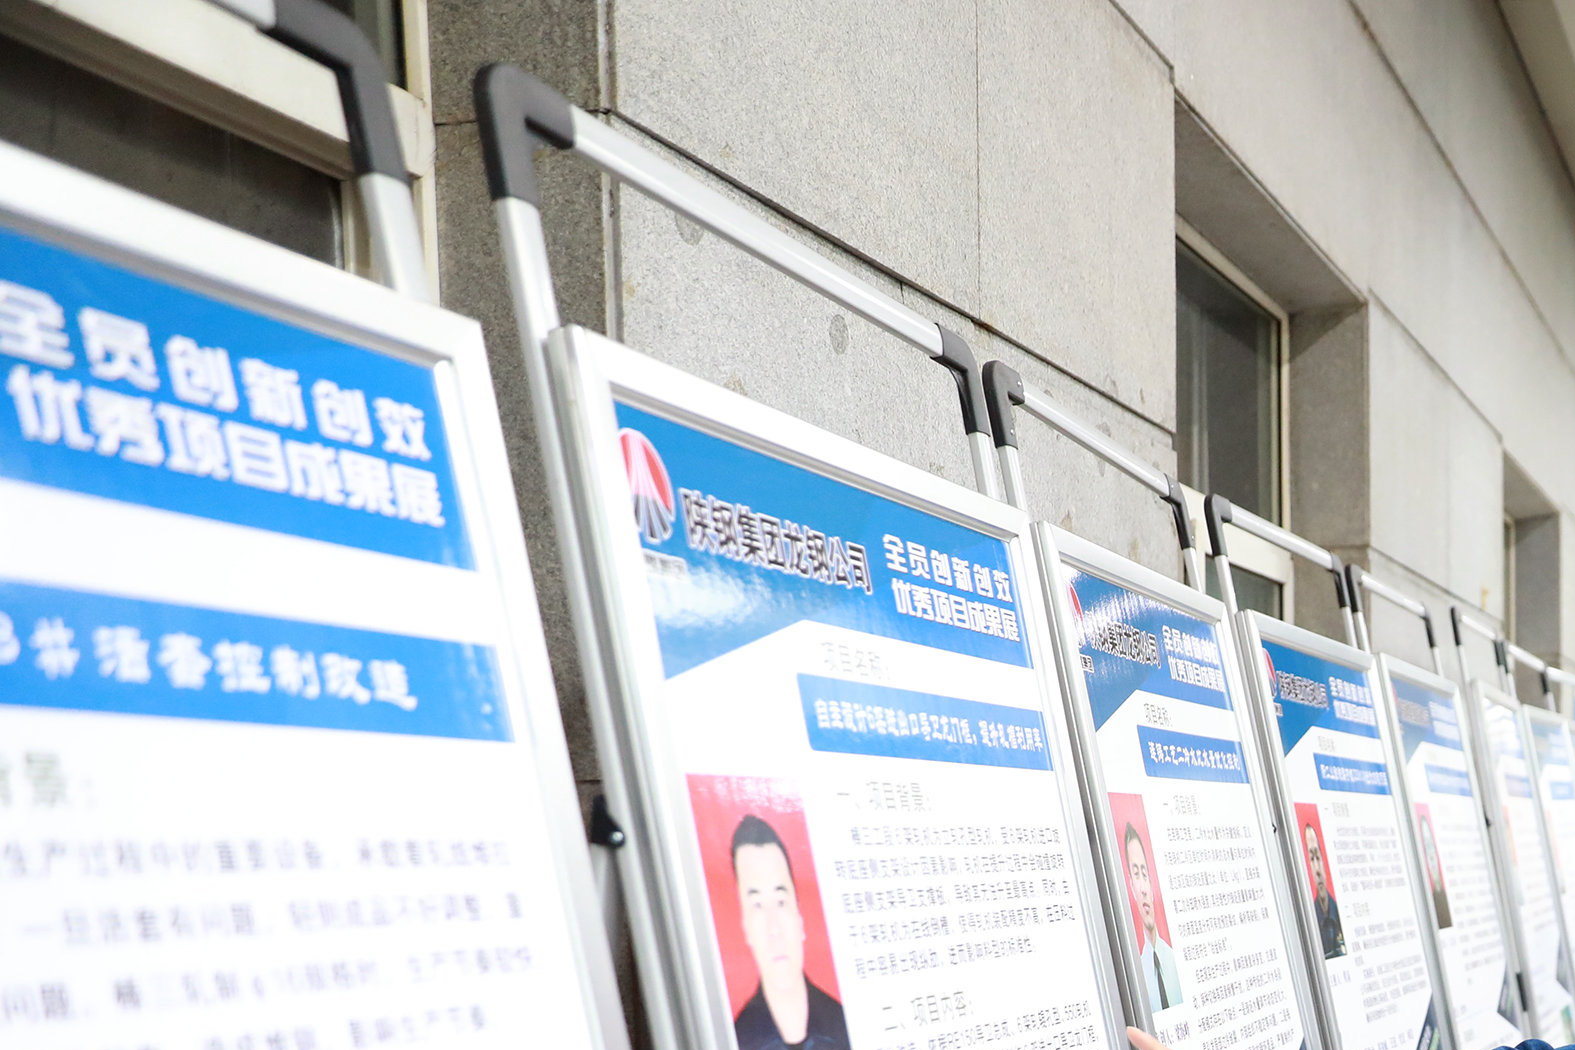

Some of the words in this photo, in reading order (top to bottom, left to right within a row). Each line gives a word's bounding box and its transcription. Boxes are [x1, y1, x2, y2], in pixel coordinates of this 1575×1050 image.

[0, 279, 432, 461] 全员创新创效
[7, 364, 446, 528] 优秀项目成果展
[678, 486, 874, 595] 陕钢集团龙钢公司
[882, 532, 1014, 604] 全员创新创效
[890, 577, 1021, 643] 优秀项目成果展
[818, 640, 892, 682] 项目名称：
[1167, 655, 1226, 693] 优秀项目成果展
[836, 780, 932, 812] 一、项目背景：
[881, 989, 976, 1033] 二、项目内容：
